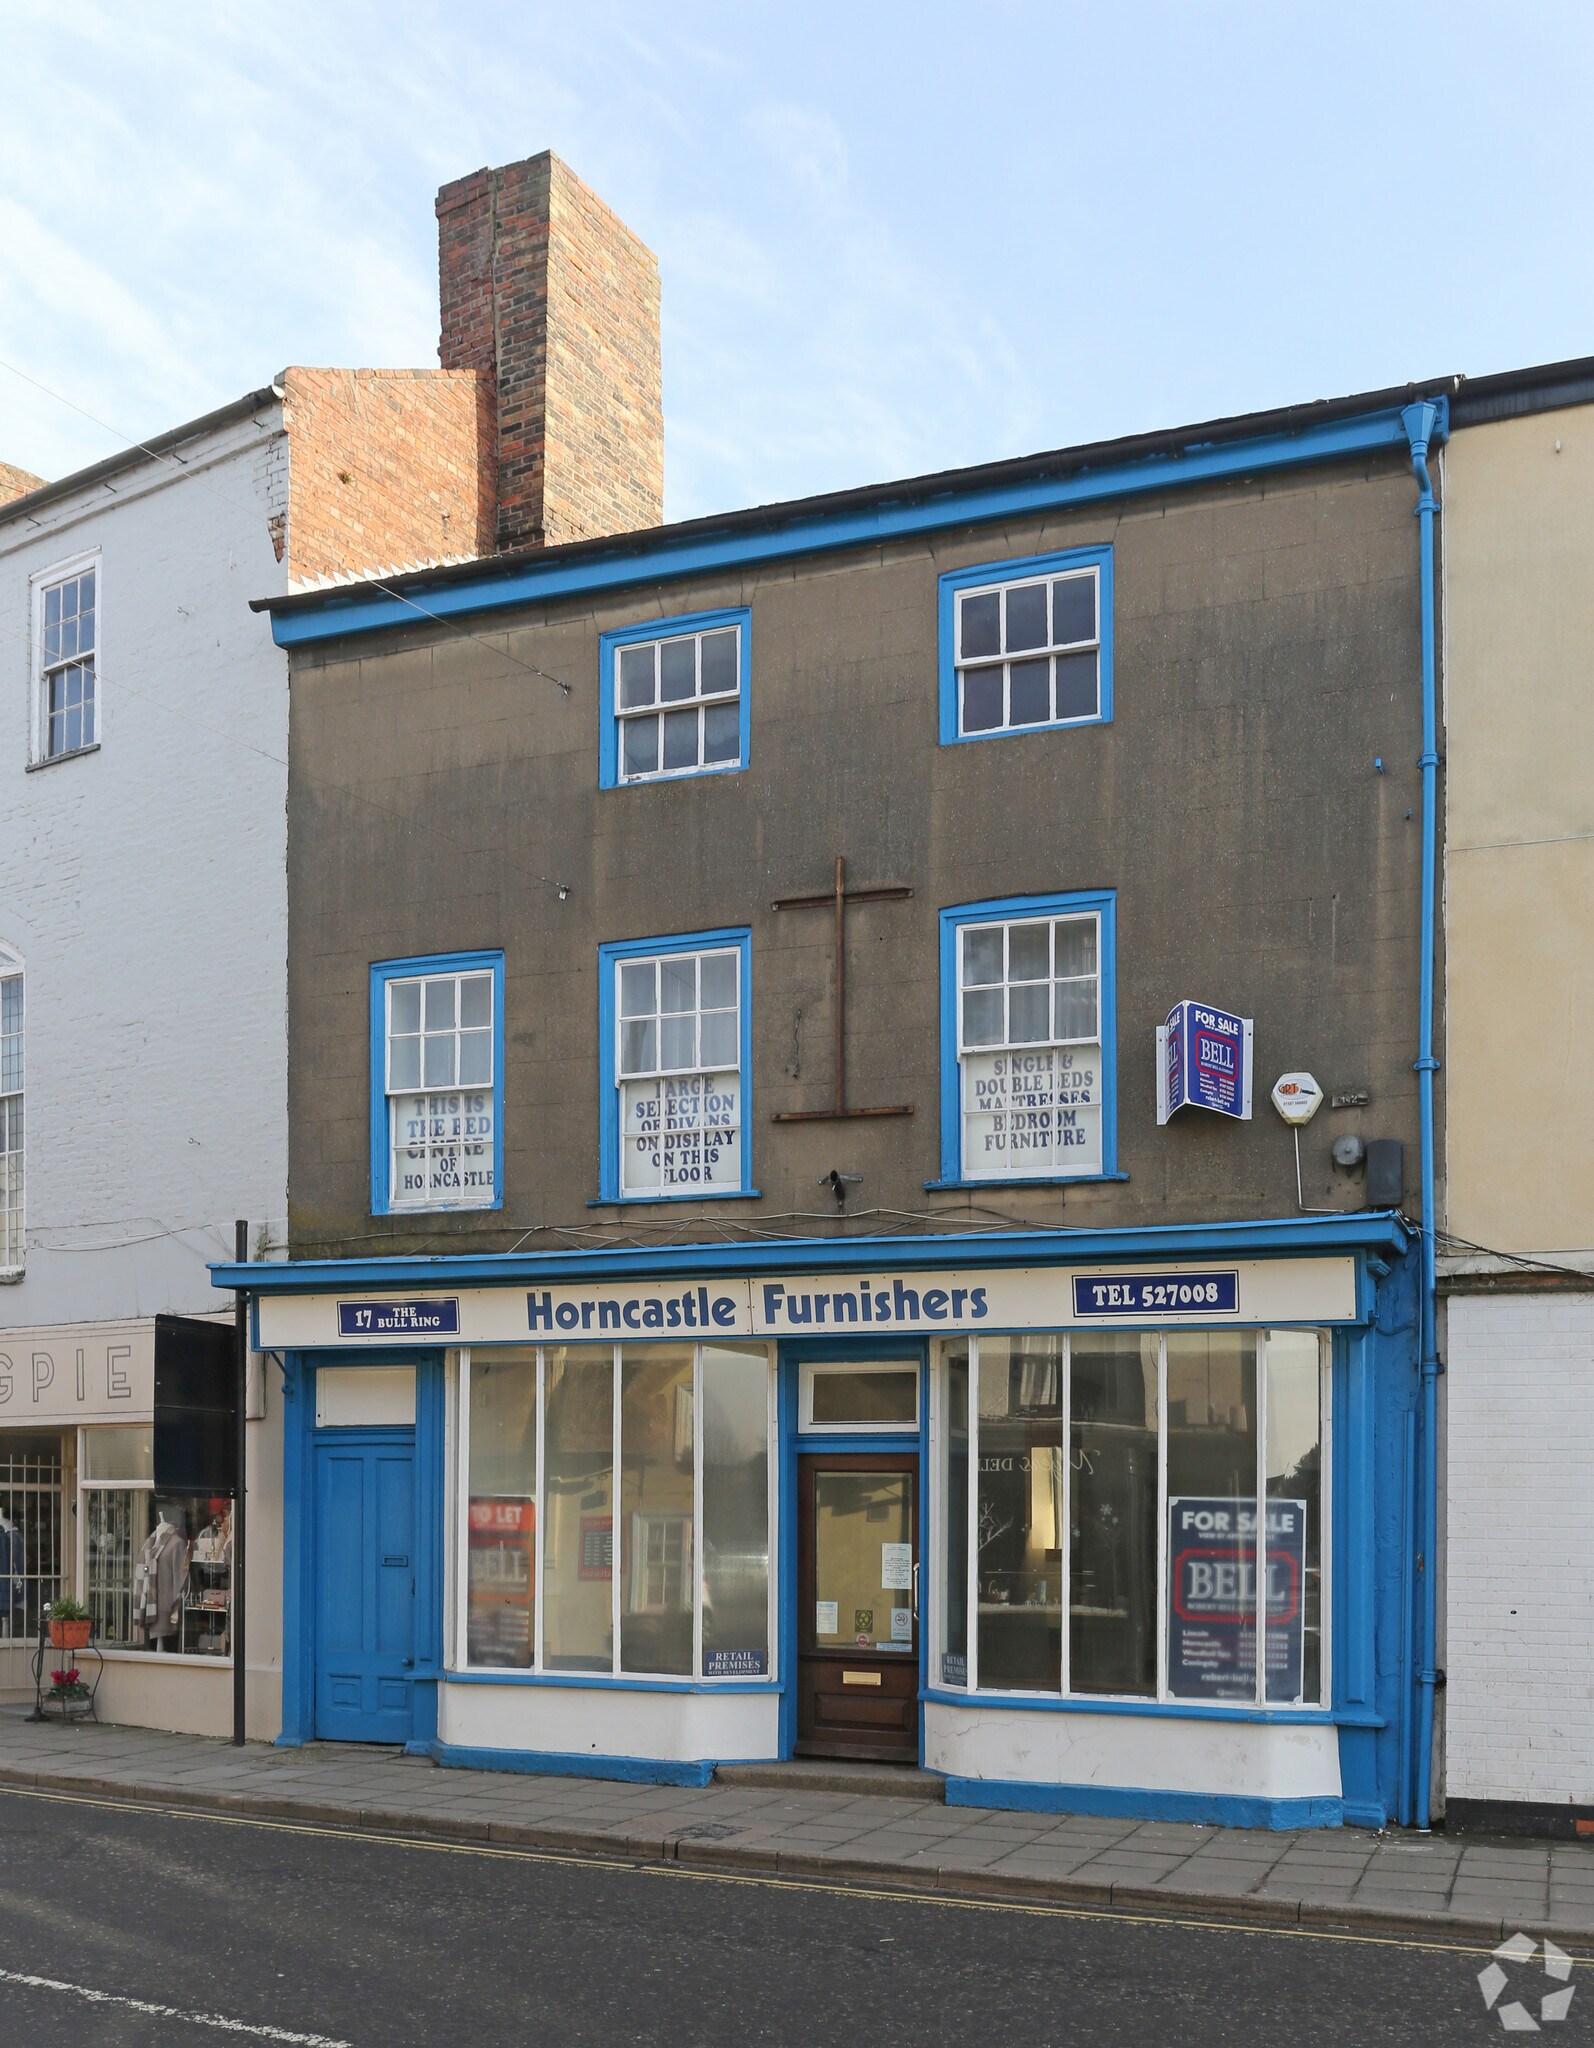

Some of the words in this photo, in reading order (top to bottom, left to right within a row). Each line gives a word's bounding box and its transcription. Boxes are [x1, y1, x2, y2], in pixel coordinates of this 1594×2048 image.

[1195, 1010, 1215, 1027] FOR
[1217, 1017, 1239, 1036] SALE
[1061, 1054, 1073, 1070] &
[1200, 1038, 1234, 1069] BELL
[464, 1094, 485, 1114] IS
[636, 1136, 659, 1152] ON
[440, 1157, 457, 1173] OF
[680, 1148, 720, 1165] THIS
[1092, 1285, 1135, 1306] TEL
[1142, 1282, 1219, 1307] 527008
[392, 1307, 417, 1318] THE
[526, 1286, 737, 1331] Horncastle
[762, 1279, 989, 1325] Furnishers
[355, 1309, 372, 1329] 17
[377, 1318, 408, 1329] BULL
[410, 1316, 441, 1328] RING
[496, 1506, 522, 1524] LET
[1182, 1511, 1230, 1531] FOR
[1187, 1562, 1286, 1601] BELL
[709, 1661, 761, 1670] PREMISES
[716, 1652, 754, 1661] RETAIL
